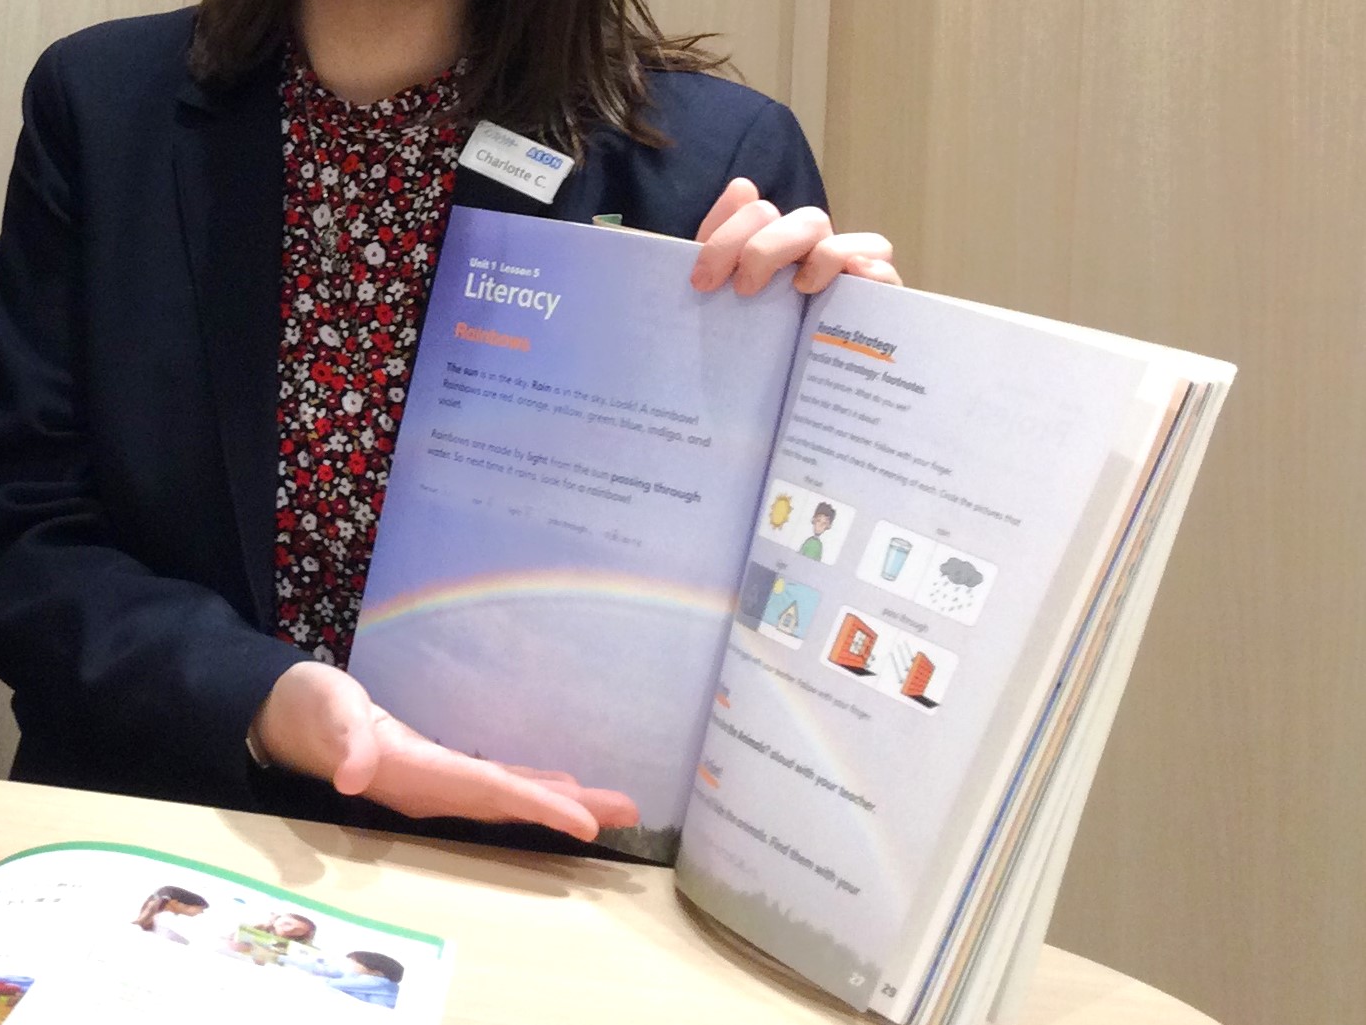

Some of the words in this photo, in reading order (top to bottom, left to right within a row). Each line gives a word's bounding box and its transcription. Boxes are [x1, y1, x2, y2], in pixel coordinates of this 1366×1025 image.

[476, 149, 532, 182] Charlotte
[535, 175, 546, 189] C.
[469, 257, 489, 270] Unit
[491, 261, 497, 270] 1
[500, 263, 532, 277] Lesson
[533, 268, 540, 278] 5
[465, 272, 561, 320] Literacy
[455, 321, 532, 352] Rainbows
[851, 330, 898, 357] Strategy
[687, 435, 712, 448] and
[610, 474, 651, 494] passing
[654, 482, 702, 504] through
